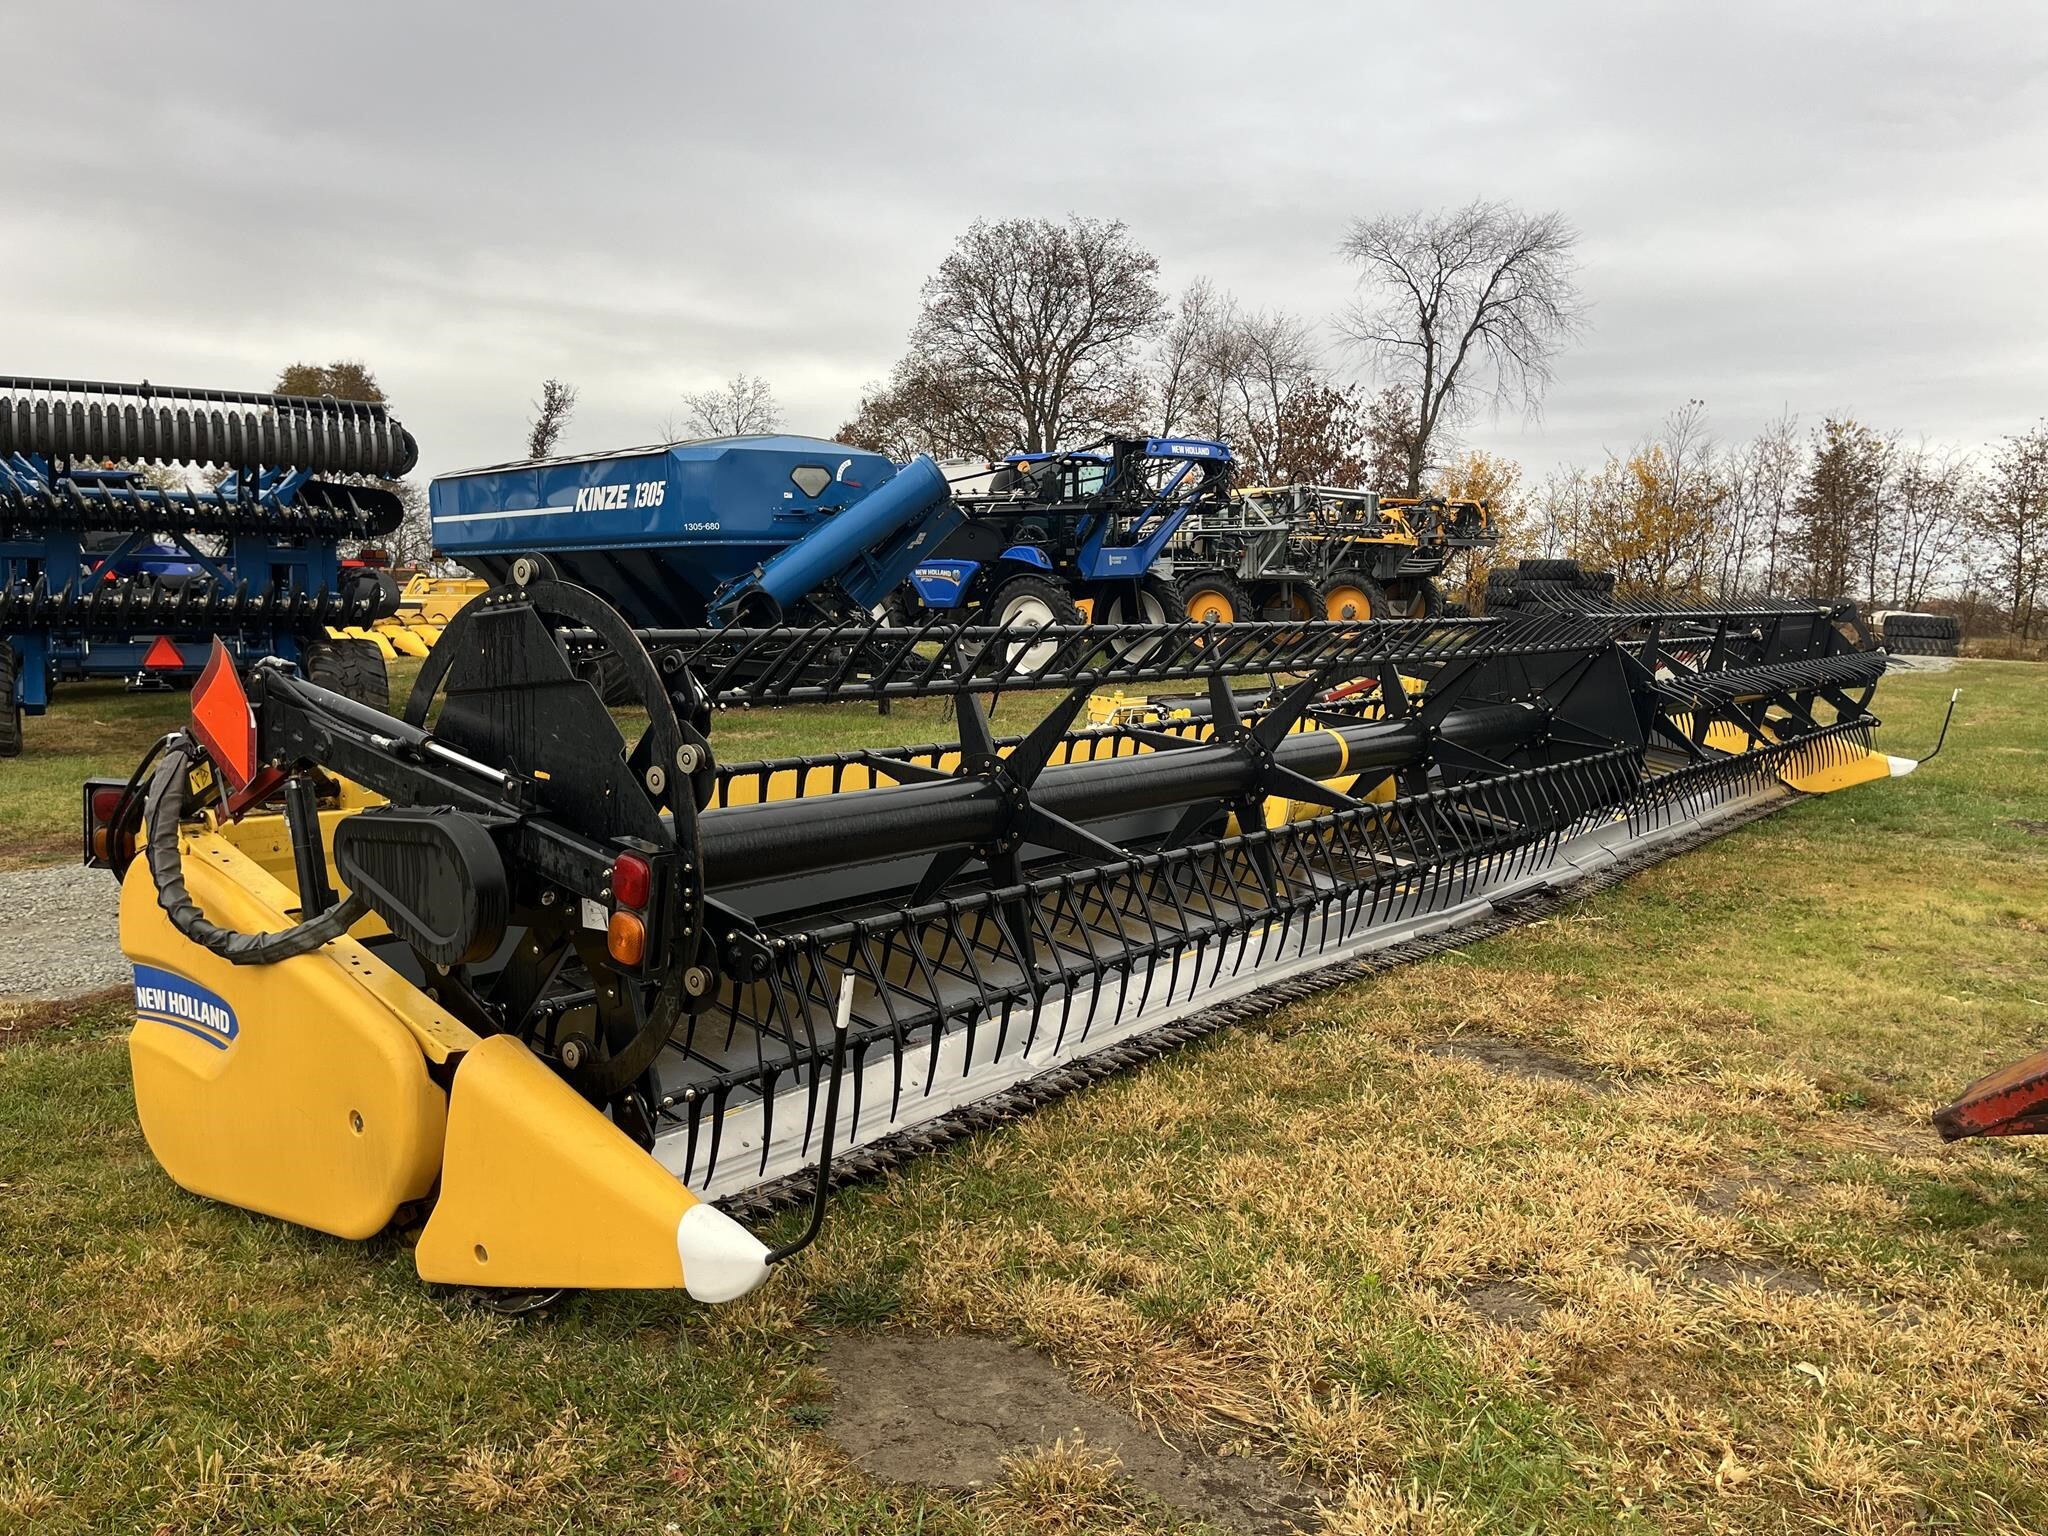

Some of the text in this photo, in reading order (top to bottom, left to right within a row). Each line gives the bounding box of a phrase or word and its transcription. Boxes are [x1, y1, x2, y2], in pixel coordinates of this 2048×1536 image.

[1171, 445, 1210, 456] NEW HOLLAND
[575, 480, 667, 513] KINZE 1305
[684, 522, 720, 531] 1305-680
[915, 568, 952, 577] NEW HOLLAND
[136, 986, 230, 1034] NEW HOLLAND
